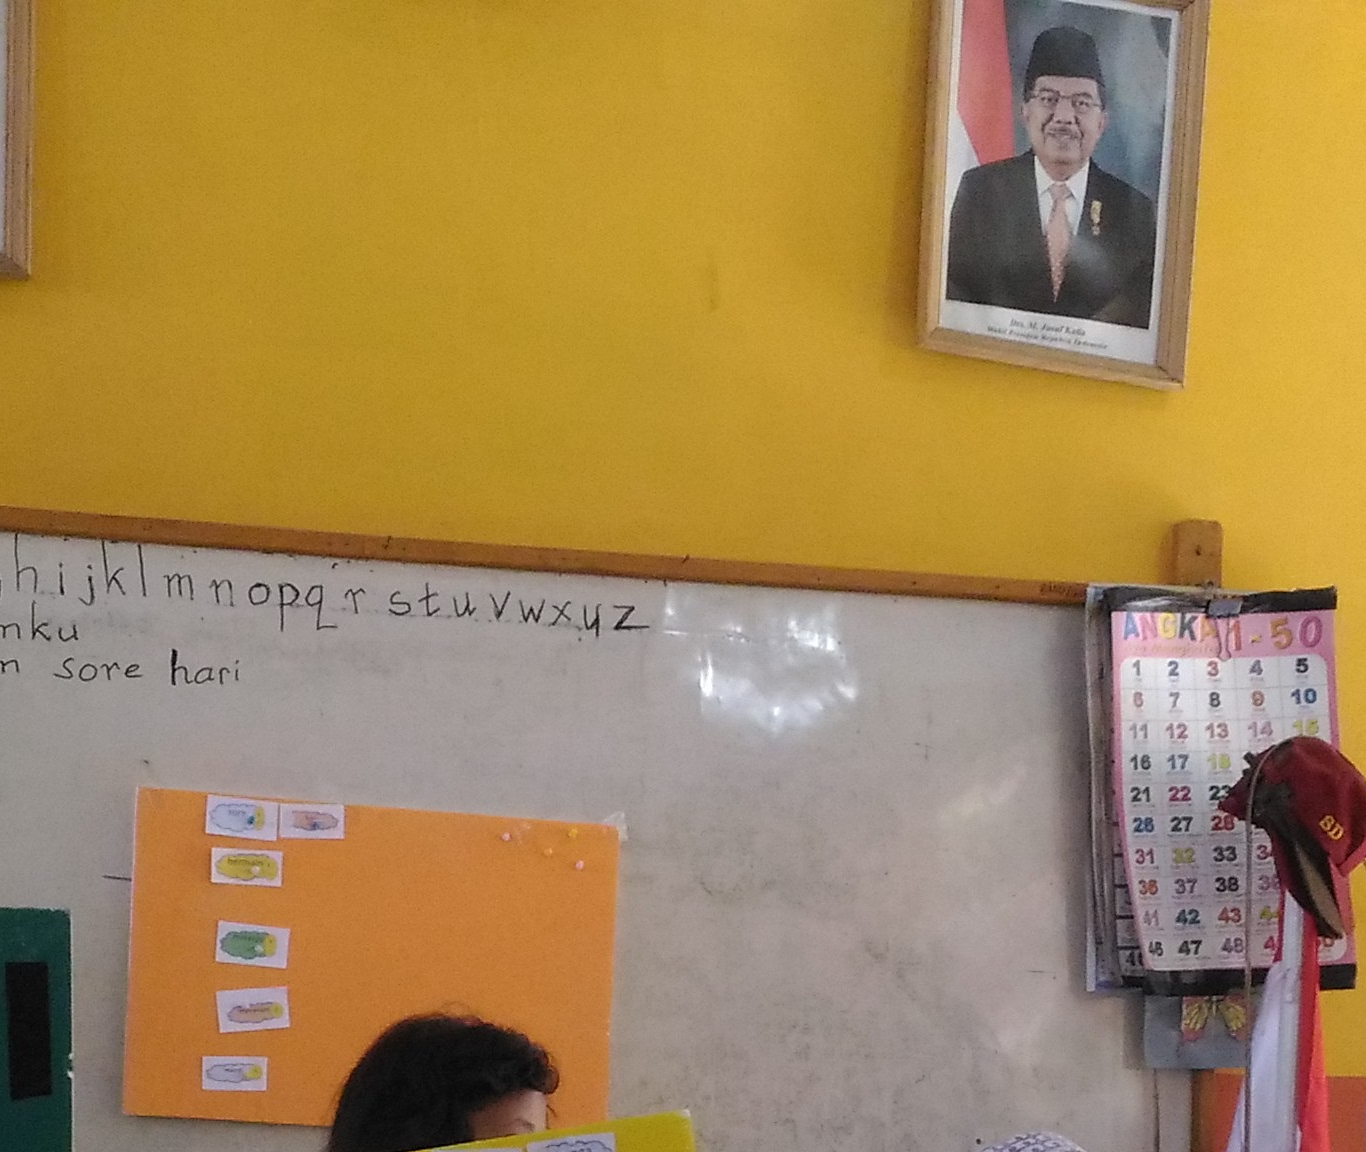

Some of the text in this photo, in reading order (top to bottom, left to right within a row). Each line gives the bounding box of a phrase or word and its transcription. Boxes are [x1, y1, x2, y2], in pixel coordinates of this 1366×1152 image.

[1123, 611, 1220, 643] ANGKA
[53, 656, 144, 682] sore
[170, 648, 242, 686] hari
[1133, 658, 1309, 677] 1 2 3 4 5
[1169, 692, 1181, 708] 7
[1208, 692, 1221, 708] 8
[1251, 691, 1265, 707] 9
[1290, 688, 1318, 705] 10
[1129, 723, 1148, 739] 11
[1165, 723, 1189, 739] 12
[1205, 722, 1230, 739] 13
[1247, 721, 1274, 738] 14
[1130, 753, 1232, 771] 16 17 18
[1130, 786, 1192, 803] 21 22
[1132, 815, 1236, 833] 26 27 28
[1135, 846, 1238, 865] 31 32 33
[1138, 877, 1240, 895] 36 37 38
[1142, 907, 1242, 927] 41 42 43
[1177, 940, 1203, 956] 47
[1220, 937, 1245, 953] 48
